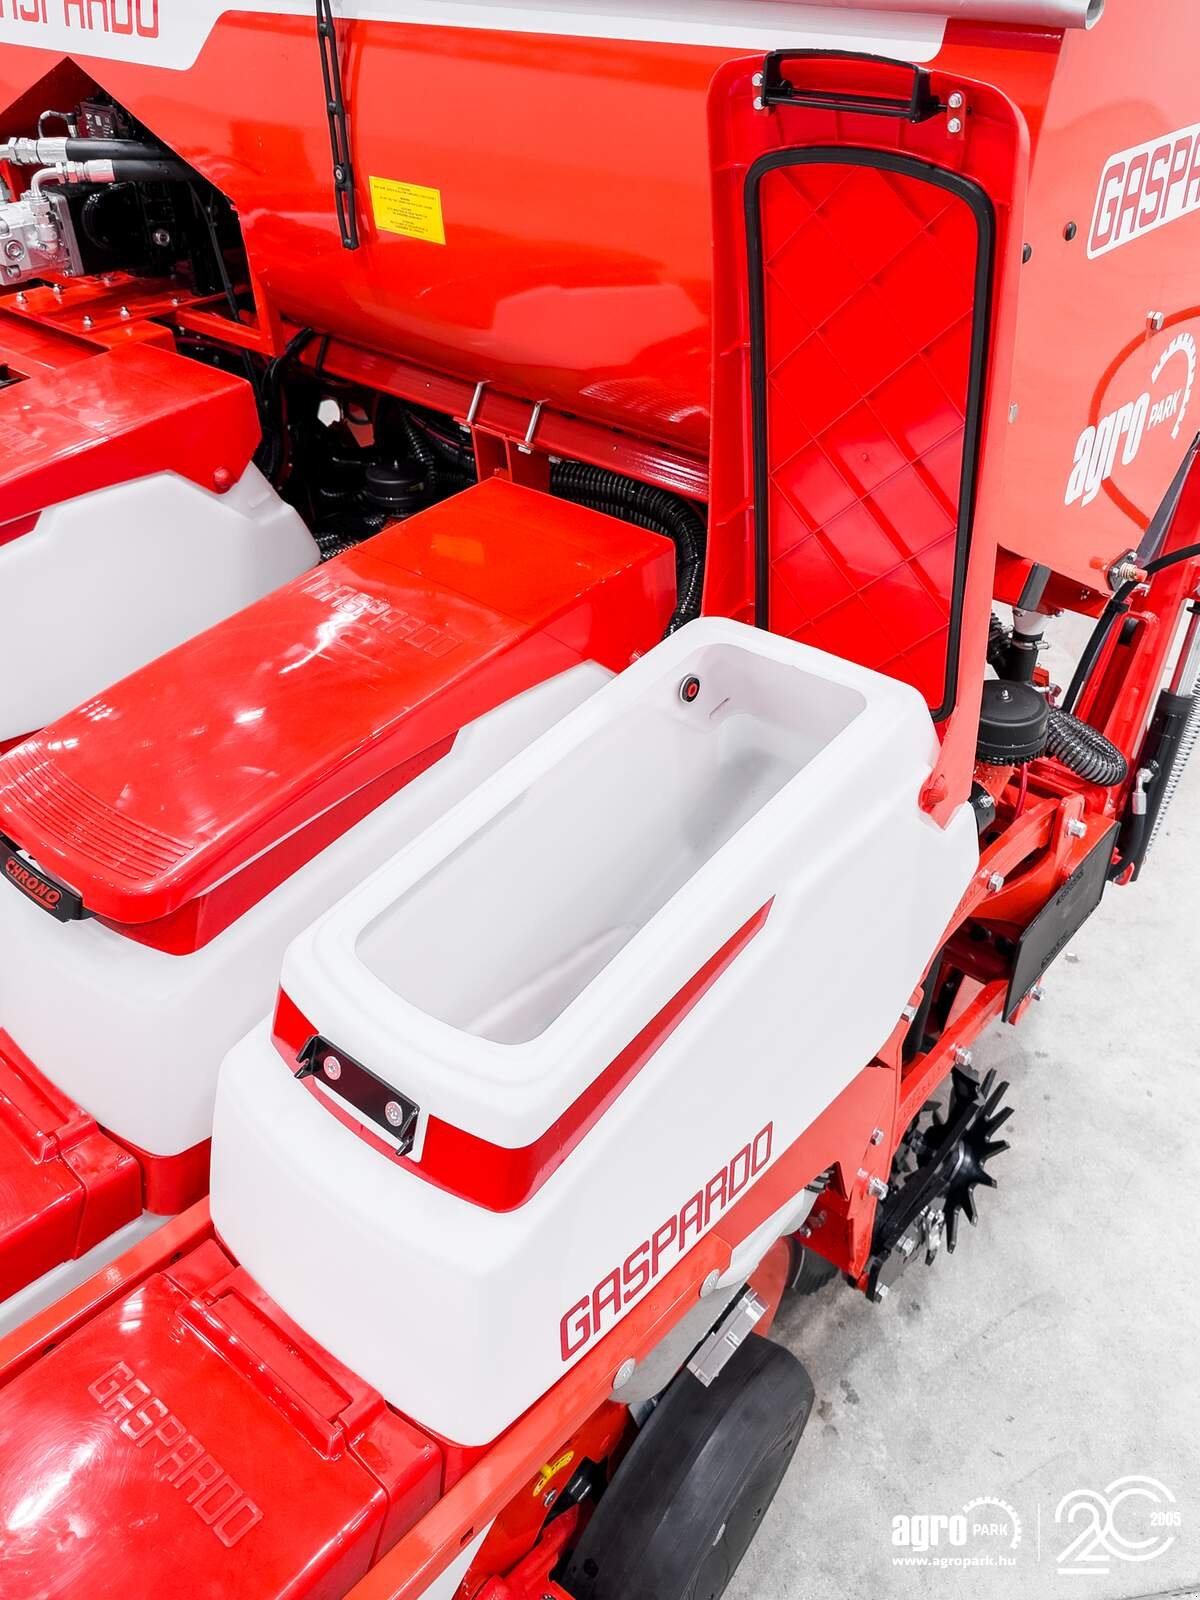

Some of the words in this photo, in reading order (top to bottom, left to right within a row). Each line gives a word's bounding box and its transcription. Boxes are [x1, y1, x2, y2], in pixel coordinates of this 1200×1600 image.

[1064, 392, 1150, 507] agro
[1147, 388, 1182, 431] PARK
[6, 859, 60, 903] CHRONO
[560, 1120, 773, 1361] GASPARDO
[88, 1360, 264, 1548] GASPARDO
